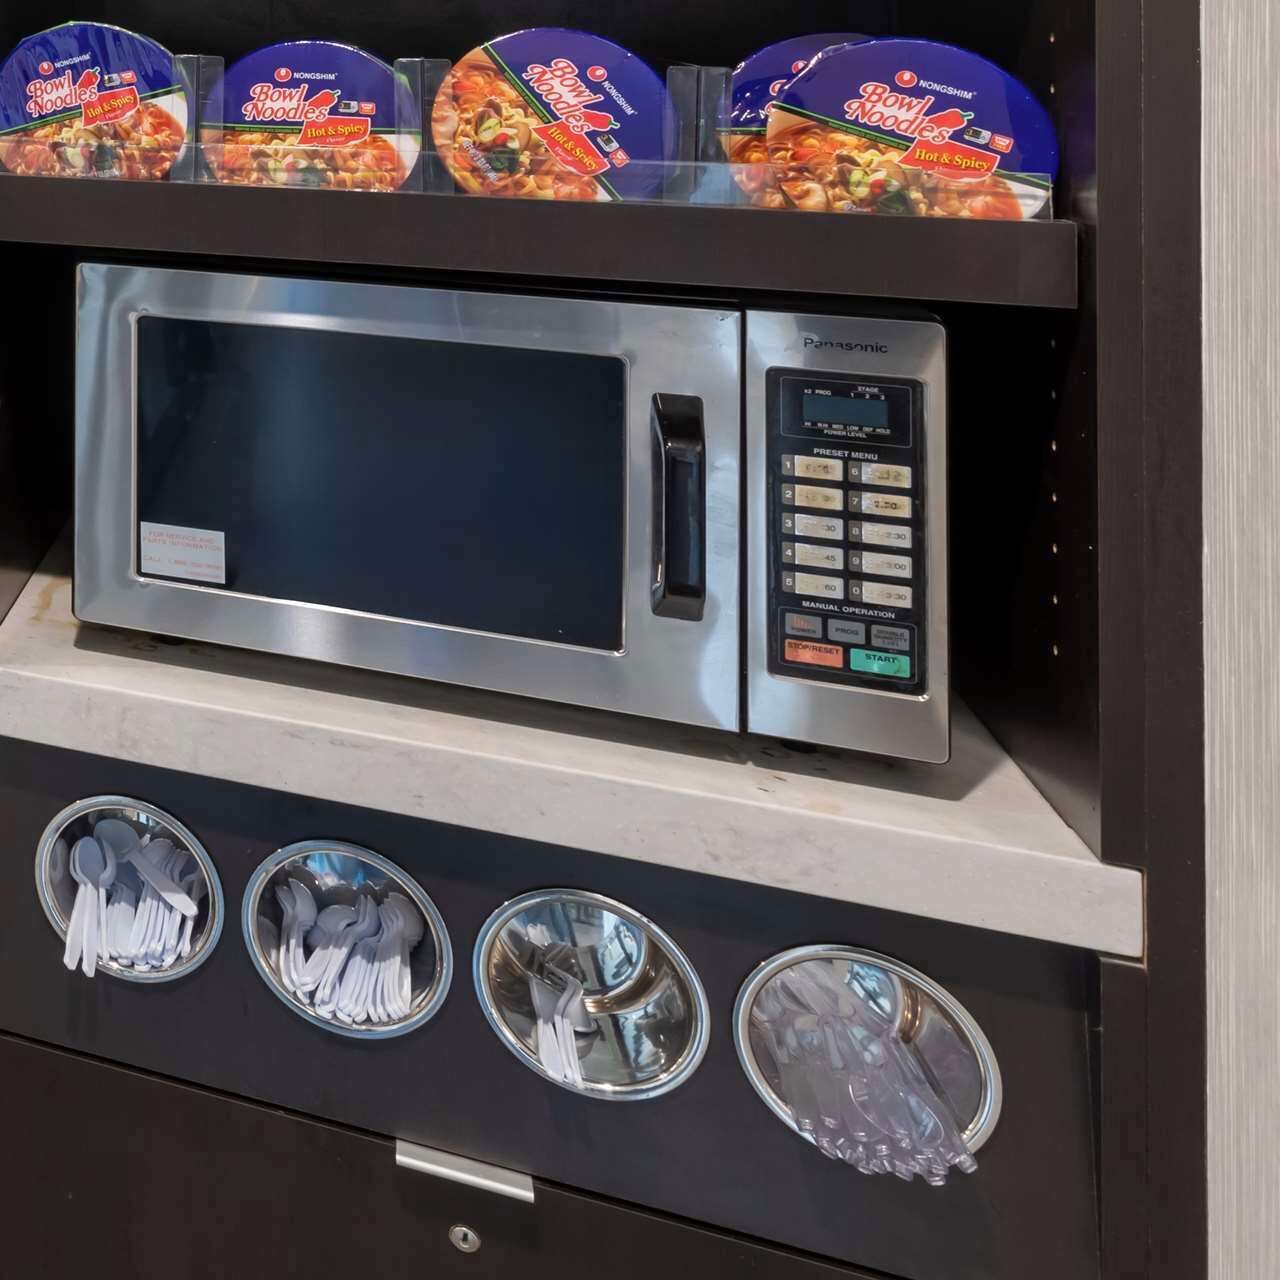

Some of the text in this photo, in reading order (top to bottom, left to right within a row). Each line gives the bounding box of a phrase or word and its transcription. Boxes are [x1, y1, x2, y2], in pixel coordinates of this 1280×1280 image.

[27, 70, 73, 100] Bowl
[294, 72, 335, 80] NONGSHIM
[551, 58, 605, 107] Bowl
[250, 83, 308, 103] Bowl
[522, 64, 592, 135] Noodles
[859, 82, 934, 116] Bowl
[919, 80, 973, 100] NONGSHIM
[26, 86, 97, 117] Noodles
[111, 94, 135, 110] Spicy
[242, 102, 330, 121] Noodles
[307, 124, 365, 137] Hot & Spicy
[844, 99, 953, 144] Noodles
[547, 126, 564, 144] Hot
[915, 148, 991, 171] Hot & Spicy
[803, 337, 889, 354] Panasonic
[813, 448, 878, 460] PRESET MENU
[802, 600, 896, 619] MANUAL OPERATION
[865, 653, 897, 663] START
